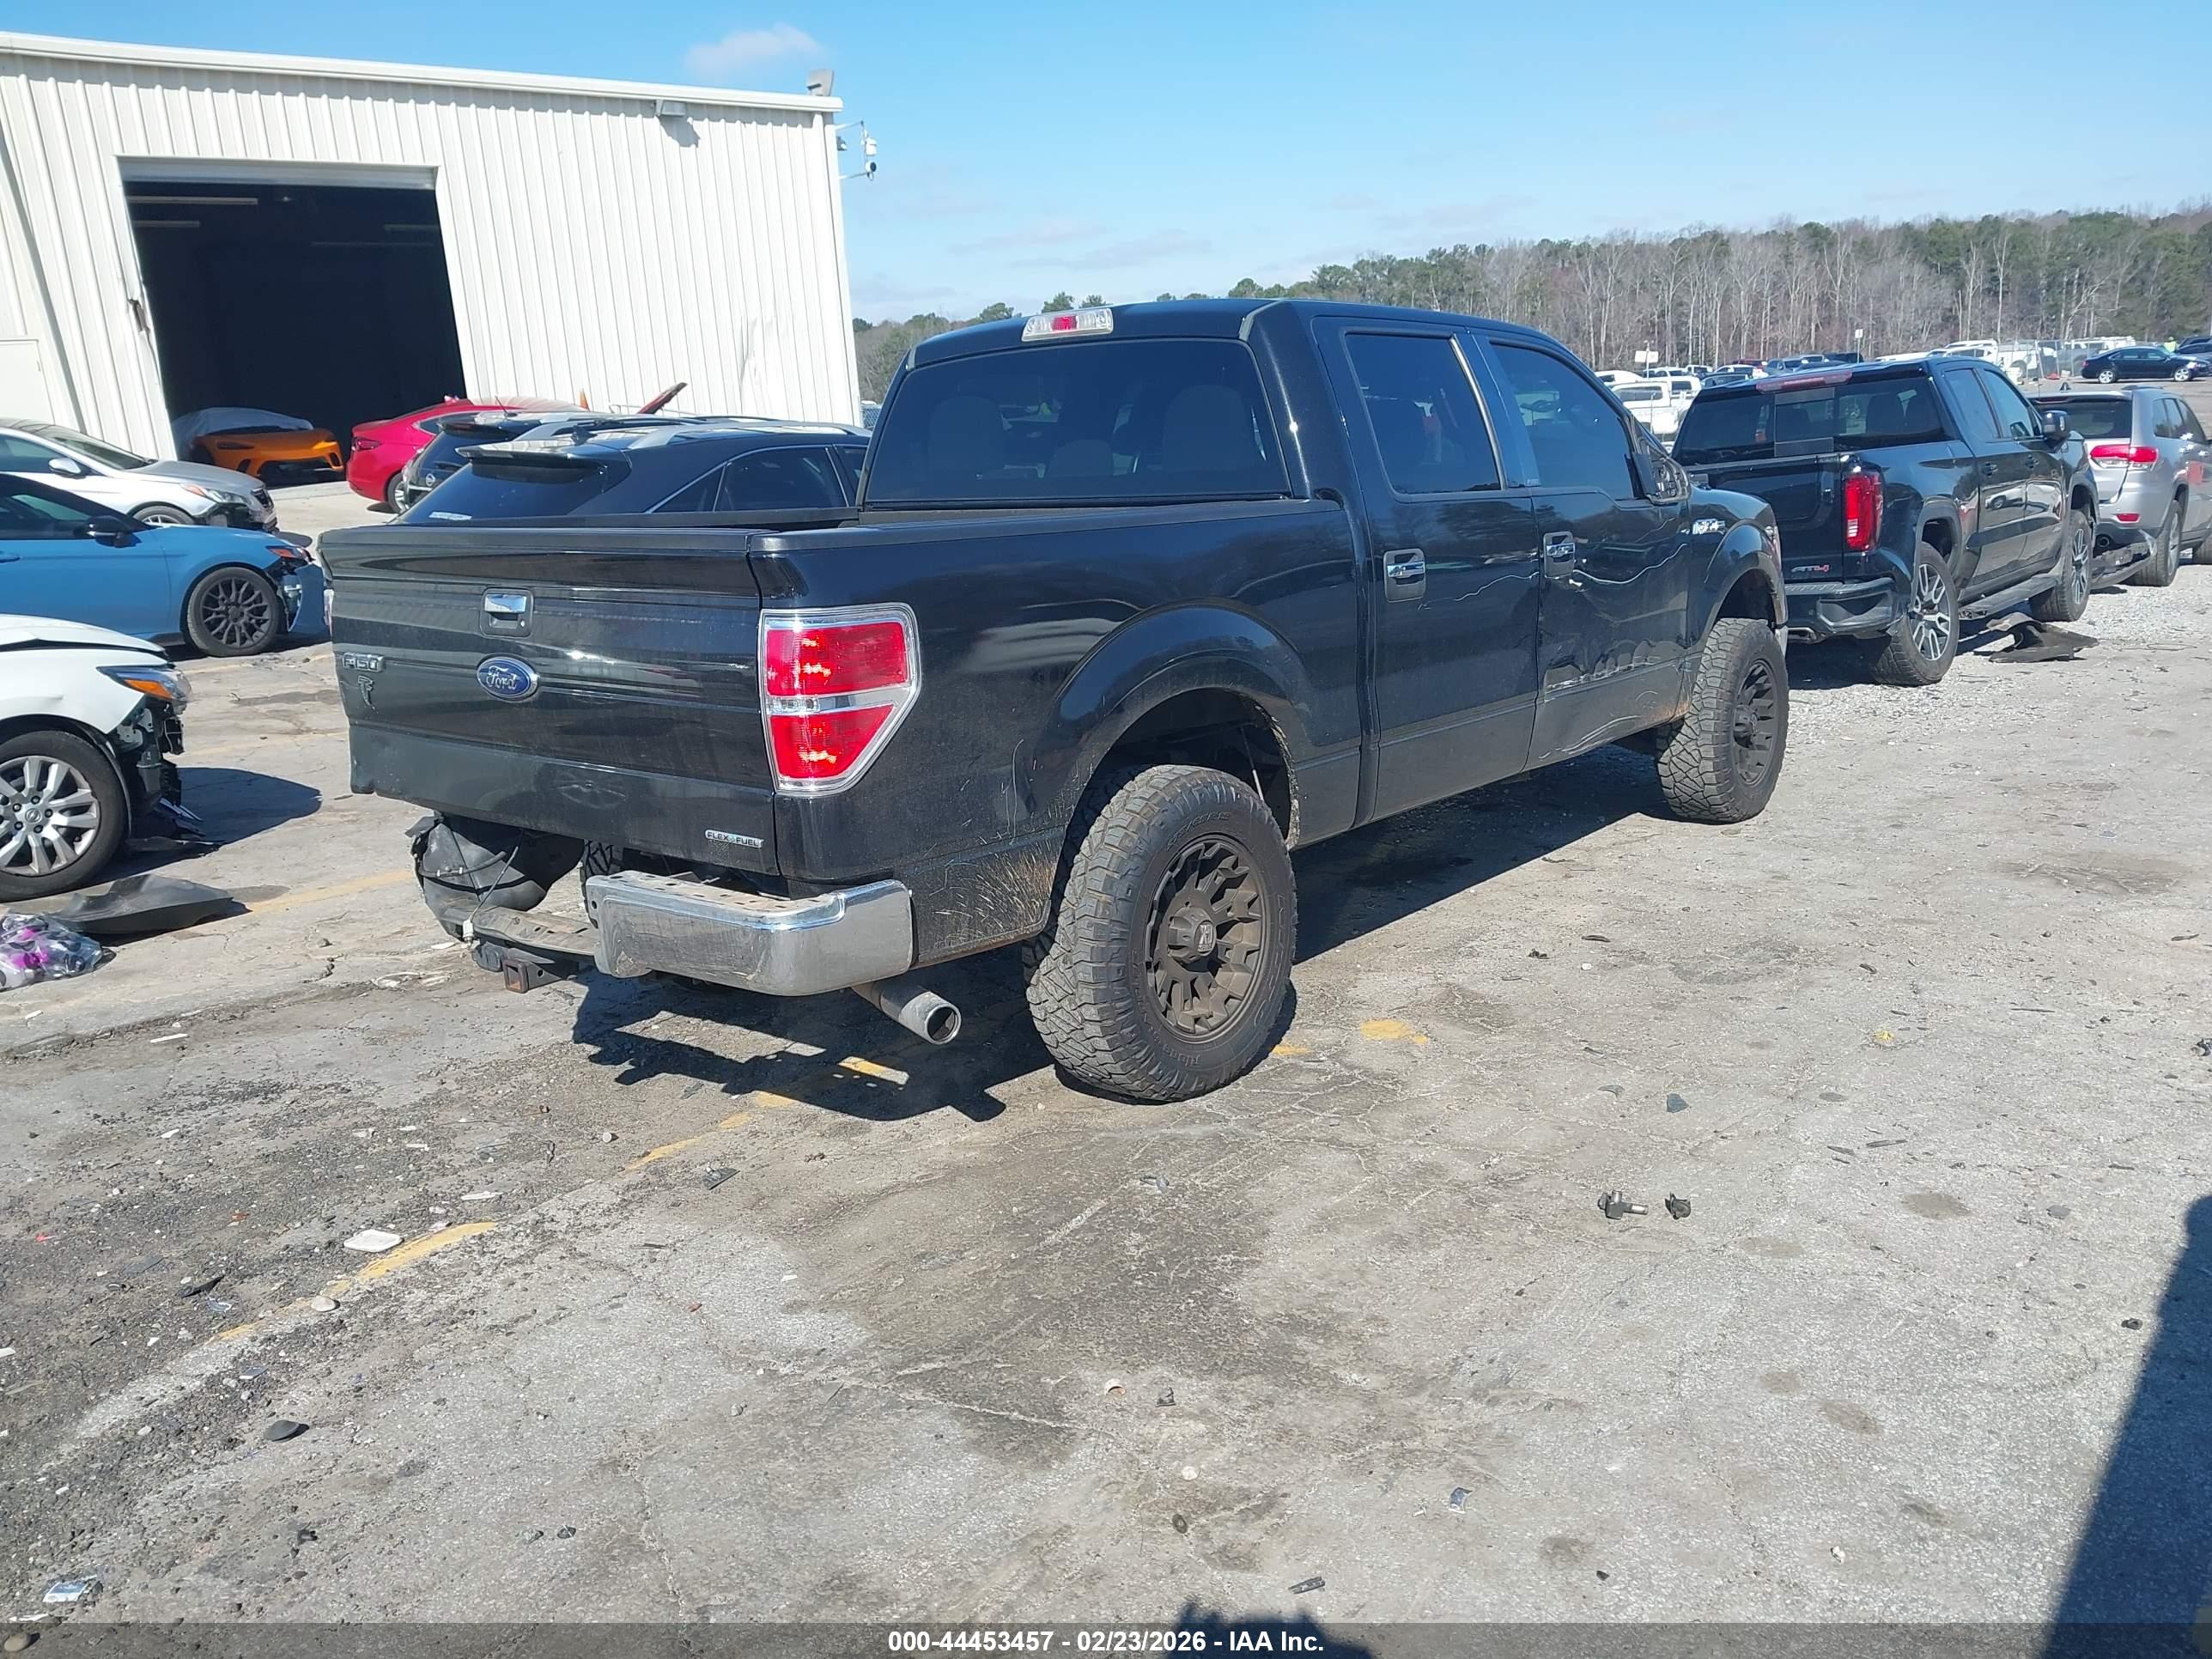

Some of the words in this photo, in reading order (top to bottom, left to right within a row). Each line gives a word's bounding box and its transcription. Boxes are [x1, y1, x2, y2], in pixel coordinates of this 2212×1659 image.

[486, 665, 518, 690] Ford
[707, 831, 729, 842] FLEX
[736, 837, 759, 847] FUEL
